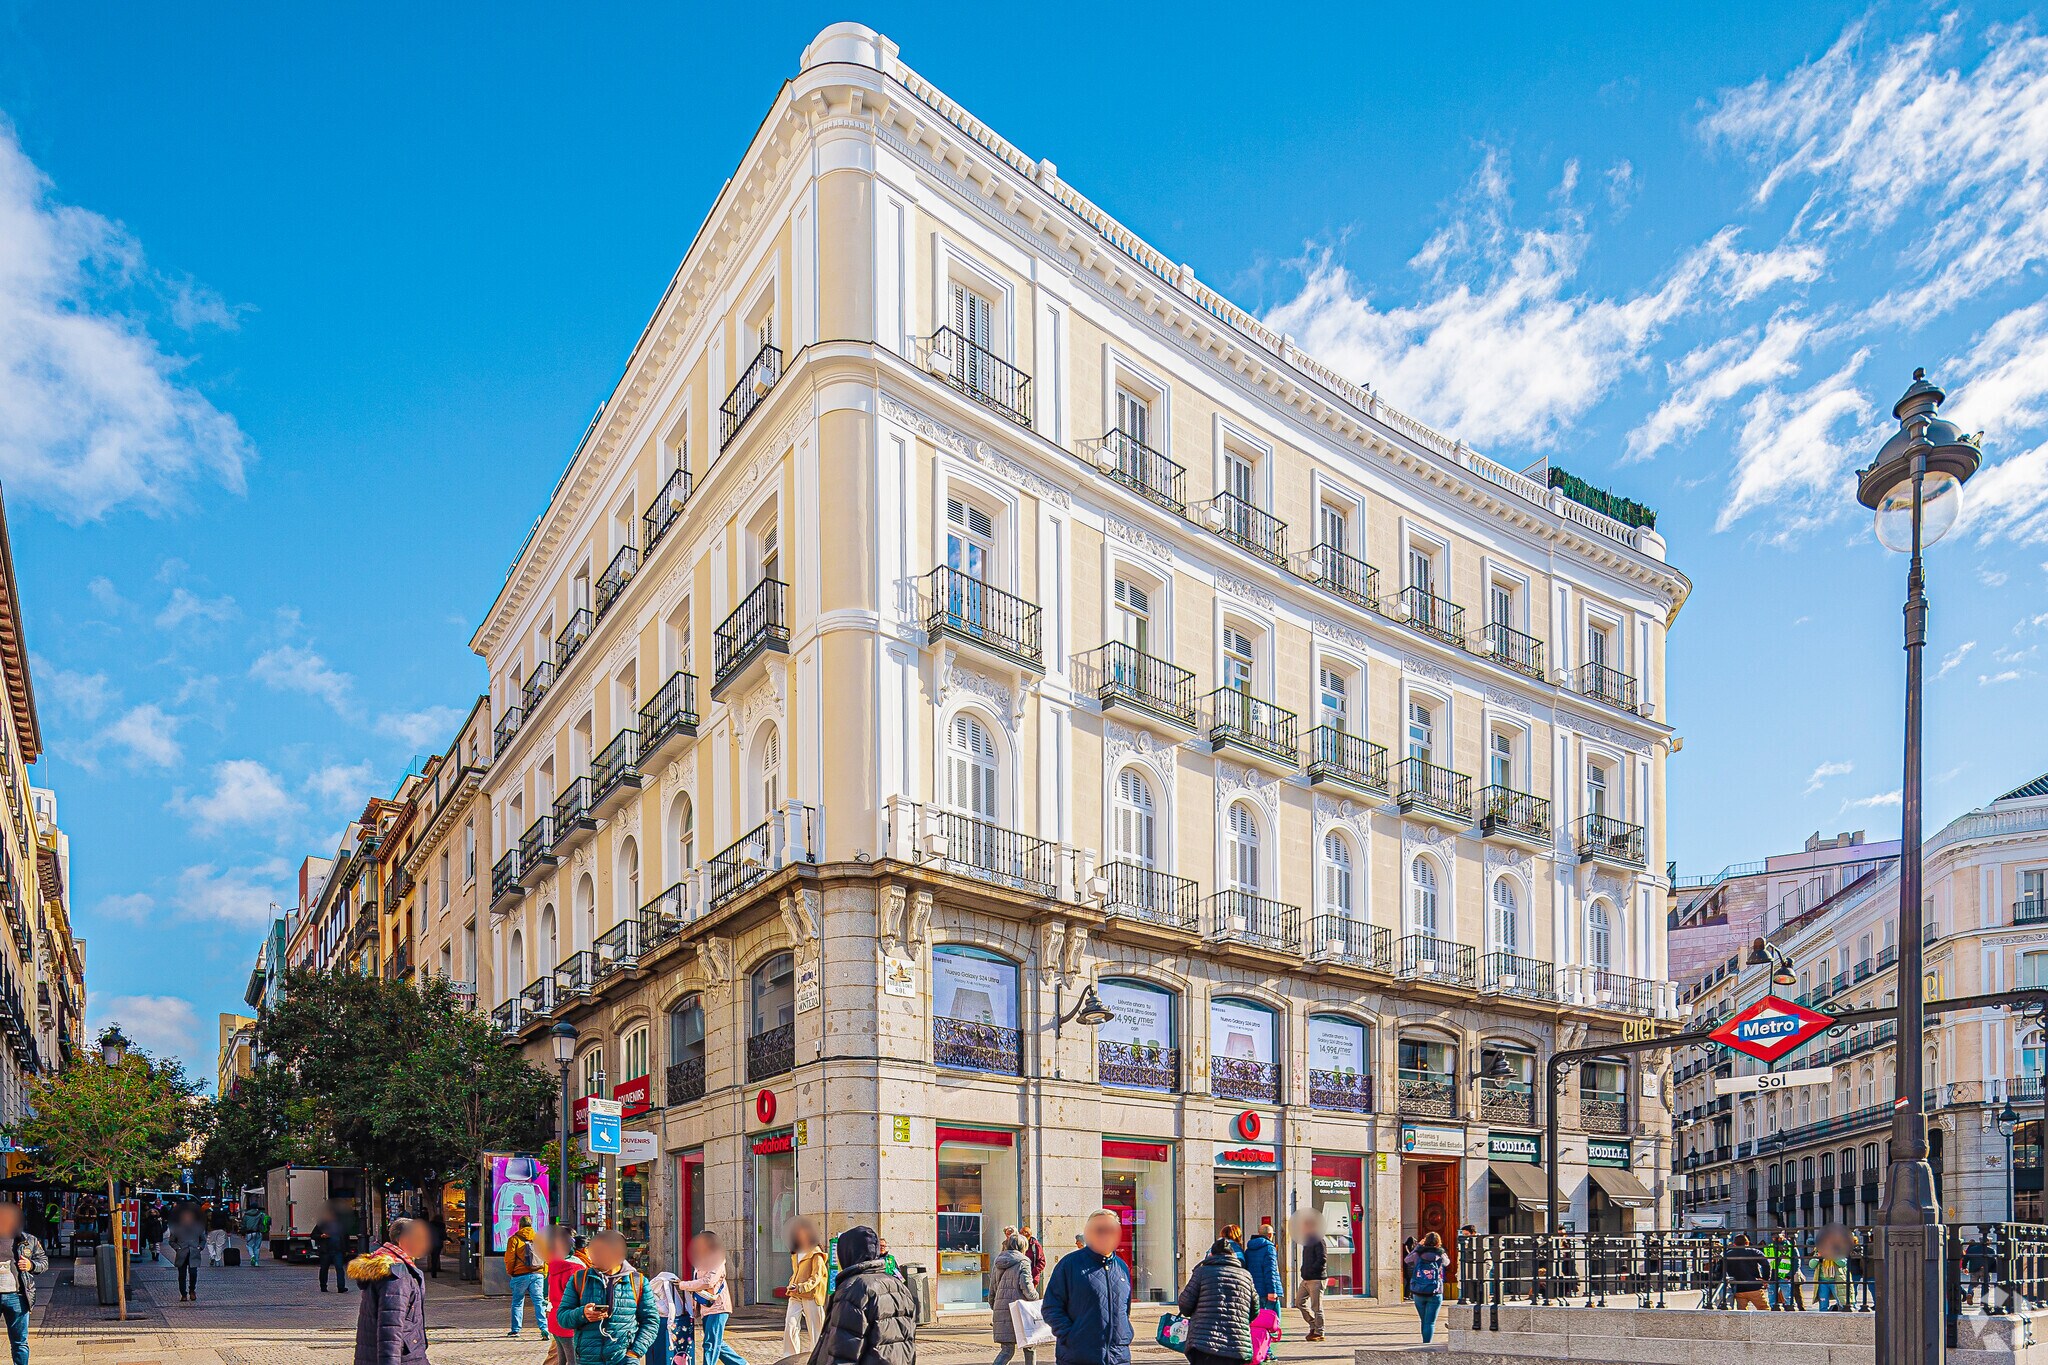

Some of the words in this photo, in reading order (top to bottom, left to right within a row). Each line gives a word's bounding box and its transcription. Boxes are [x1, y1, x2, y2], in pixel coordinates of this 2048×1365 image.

[945, 968, 960, 977] Nuevo
[961, 971, 978, 981] Galaxy
[979, 974, 987, 982] S24
[988, 975, 1000, 984] Ultra
[895, 987, 906, 995] SOL
[1744, 1020, 1794, 1037] Metro
[1758, 1074, 1787, 1088] Sol
[617, 1088, 645, 1107] SOUVENIRS
[620, 1137, 651, 1145] SOUVENIRS
[752, 1136, 790, 1155] vodafone
[1439, 1140, 1447, 1148] del
[1492, 1140, 1537, 1154] RODILLA
[1588, 1146, 1629, 1160] RODILLA
[1314, 1179, 1333, 1188] Galaxy
[1334, 1180, 1343, 1188] S24
[1343, 1180, 1357, 1188] Ultra
